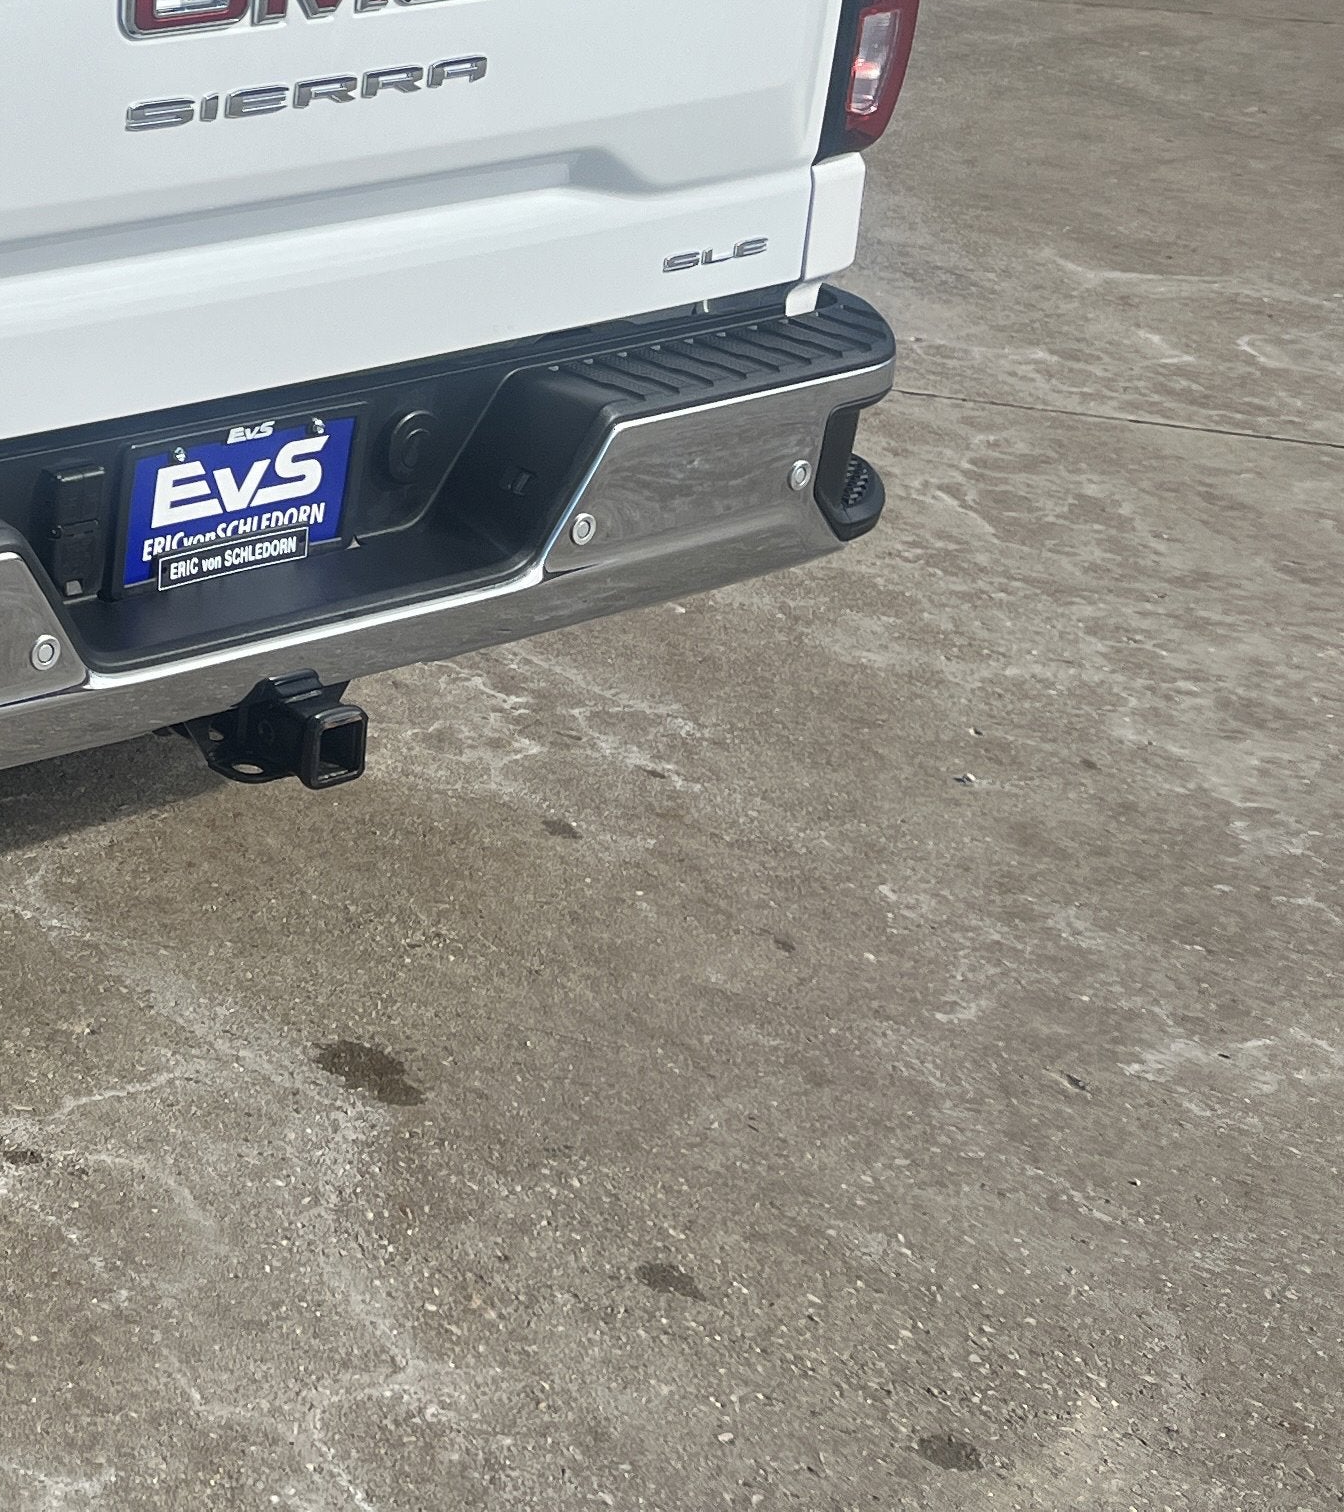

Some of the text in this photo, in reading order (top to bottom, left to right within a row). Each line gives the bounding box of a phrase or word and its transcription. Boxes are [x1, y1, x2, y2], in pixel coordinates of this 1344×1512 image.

[124, 54, 488, 132] SIERRA
[662, 237, 769, 273] SLE
[170, 536, 297, 580] ERIC von SCHLEDORN
